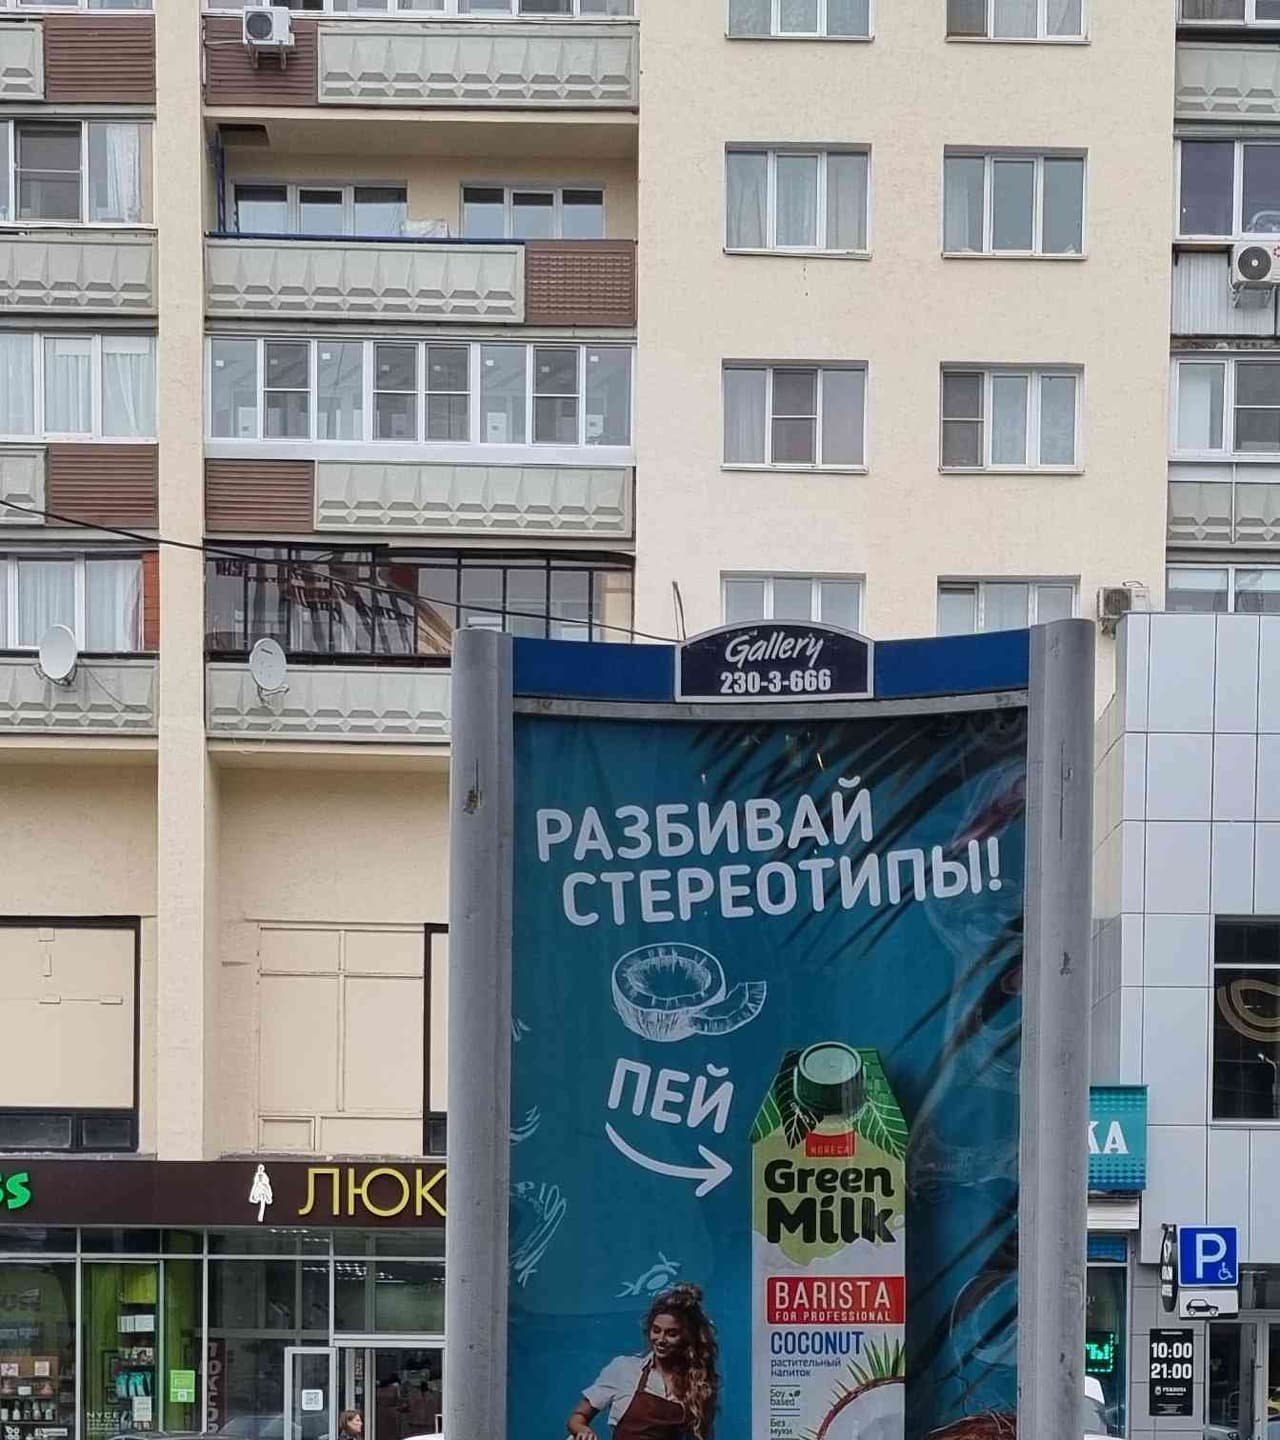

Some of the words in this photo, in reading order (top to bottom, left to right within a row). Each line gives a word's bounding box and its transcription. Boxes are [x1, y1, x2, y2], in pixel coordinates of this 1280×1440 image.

[724, 630, 824, 668] Gallery
[719, 669, 832, 694] 230-3-666
[535, 775, 873, 864] РАЗБИВАЙ
[561, 837, 1002, 926] СТЕРЕОТИПЫ!
[606, 1056, 734, 1134] ПЕЙ
[764, 1159, 895, 1198] Green
[766, 1195, 897, 1244] Milk
[775, 1281, 891, 1309] BARISTA
[775, 1311, 797, 1322] FOR
[803, 1311, 891, 1322] PROFESSIONAL
[770, 1331, 864, 1355] COCONUT
[1151, 1342, 1193, 1359] 10:00
[1150, 1363, 1193, 1379] 21:00
